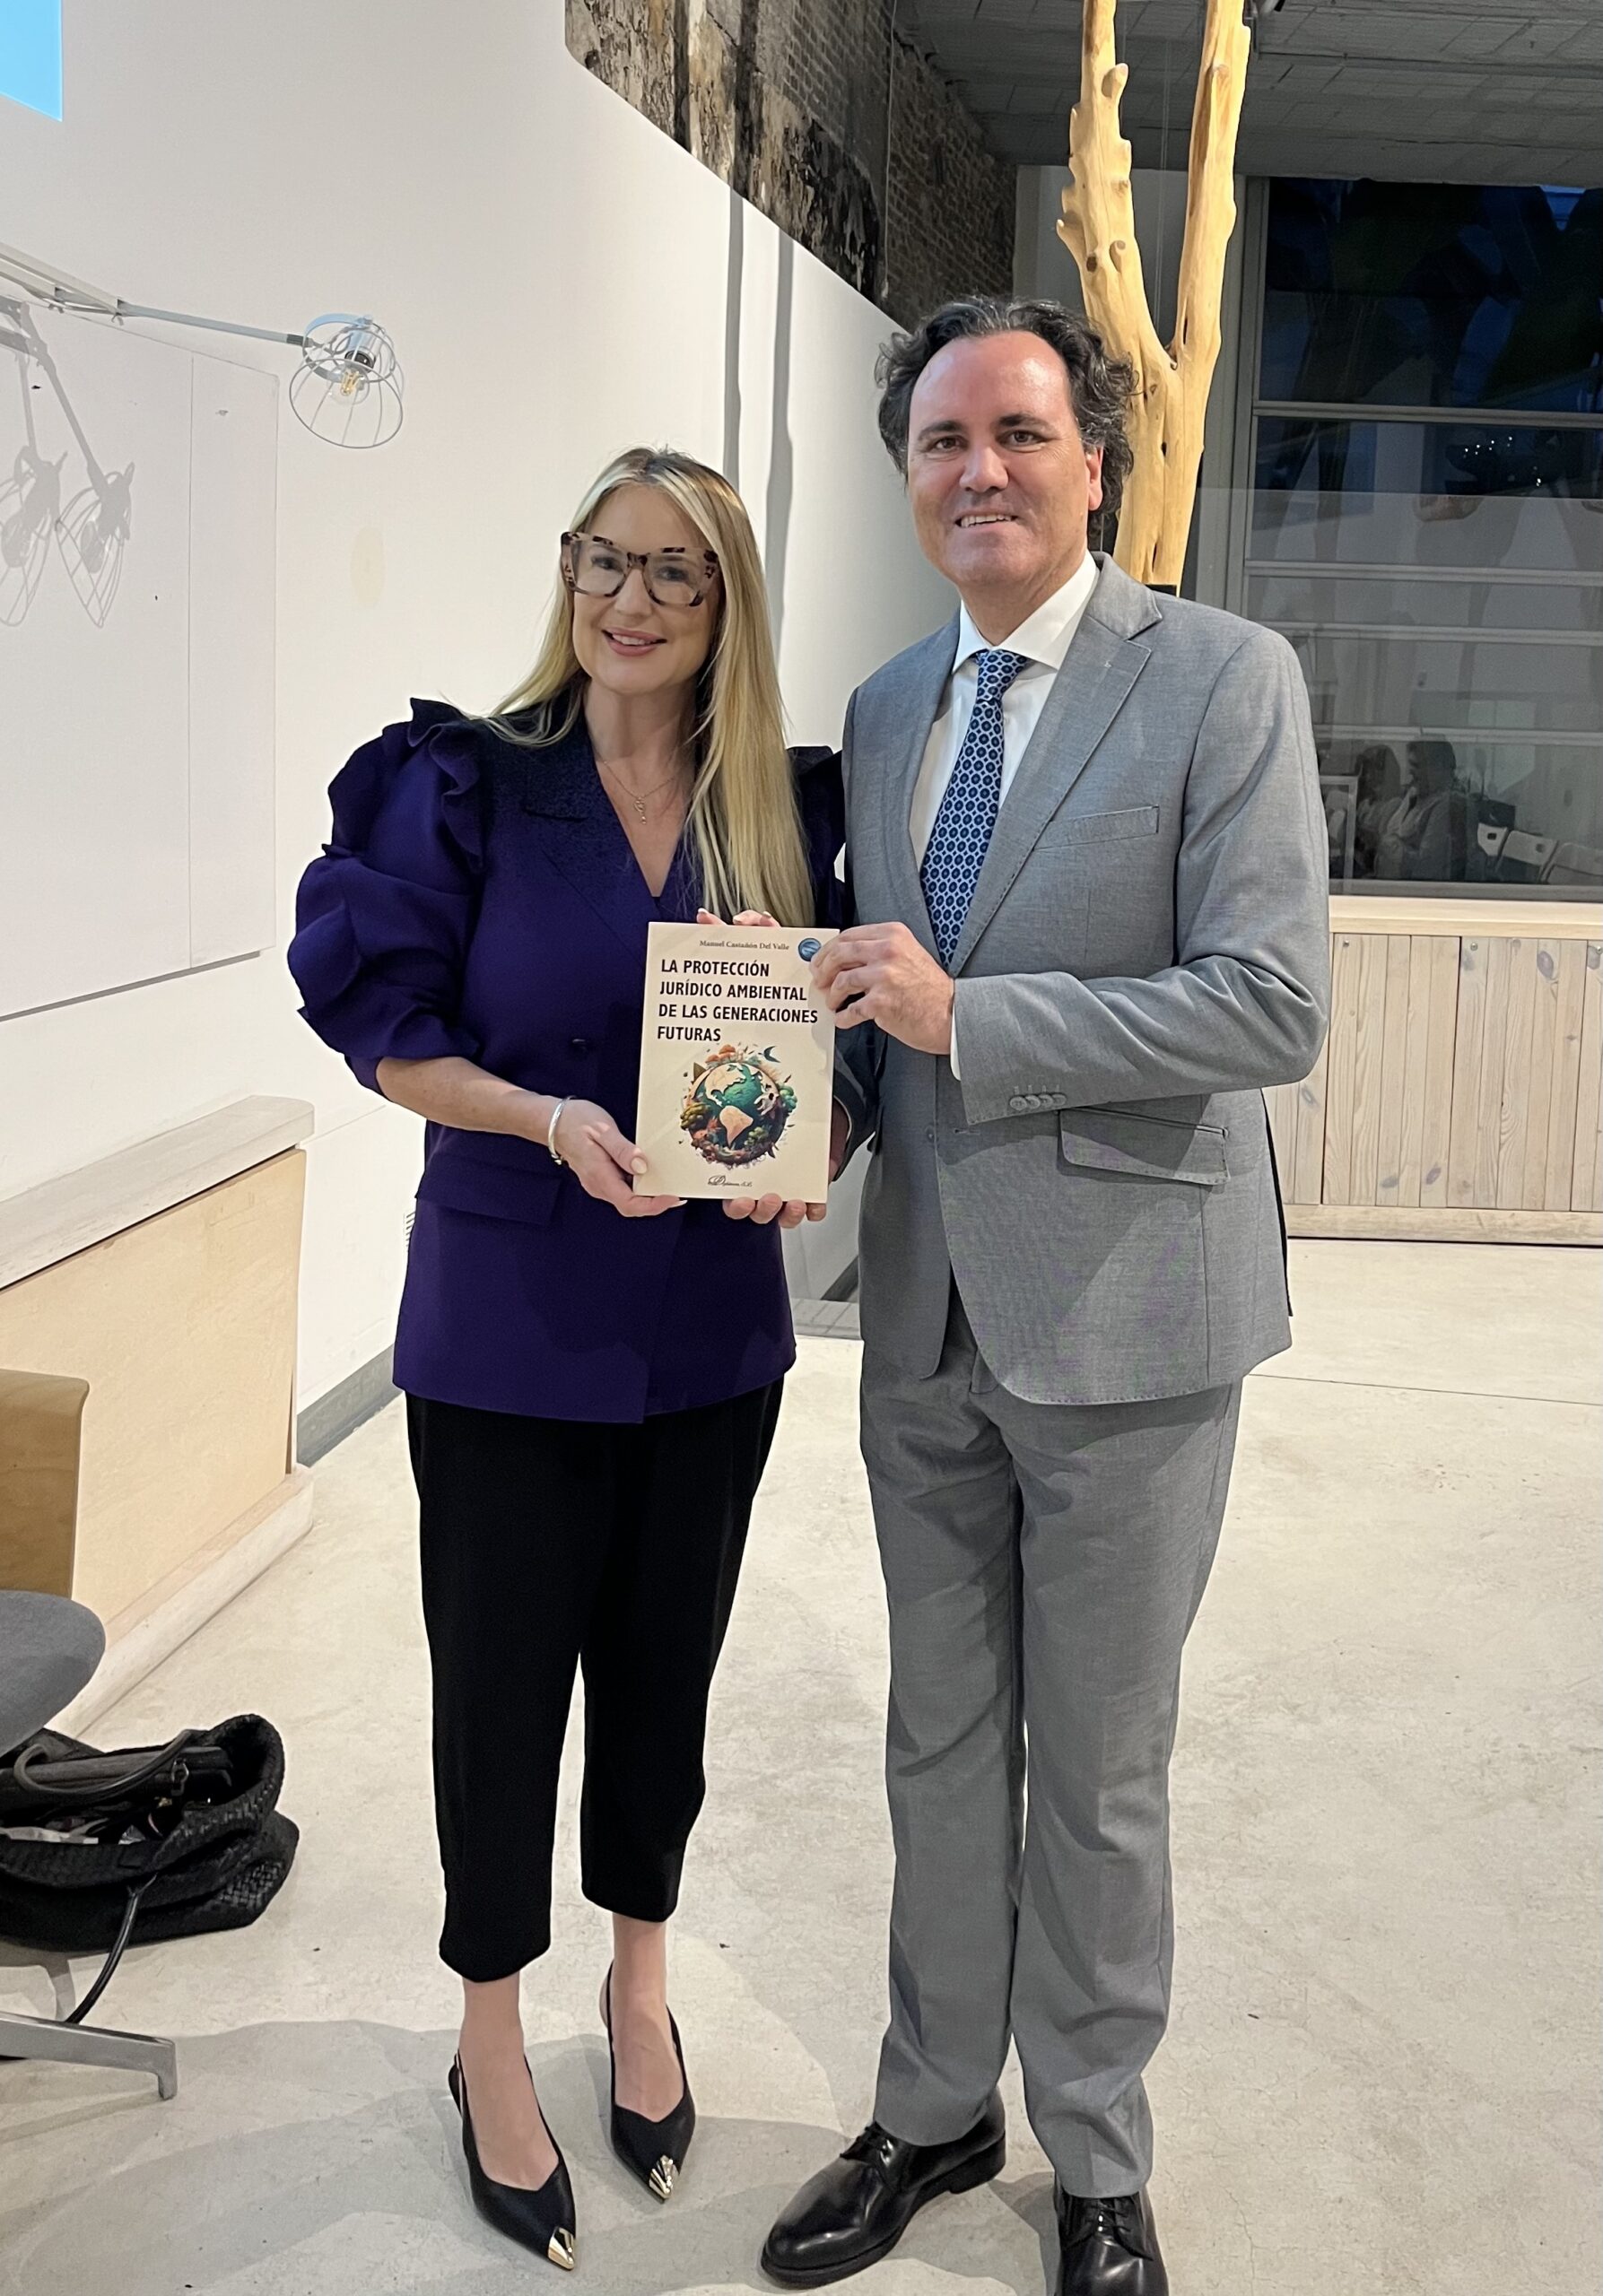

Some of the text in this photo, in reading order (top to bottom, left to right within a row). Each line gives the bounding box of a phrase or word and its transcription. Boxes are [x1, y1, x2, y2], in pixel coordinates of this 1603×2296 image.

[661, 959, 770, 977] LA PROTECCIÓN
[659, 978, 807, 1001] JURÍDICO AMBIENTAL
[658, 1004, 818, 1023] DE LAS GENERACIONES
[658, 1026, 721, 1041] FUTURAS
